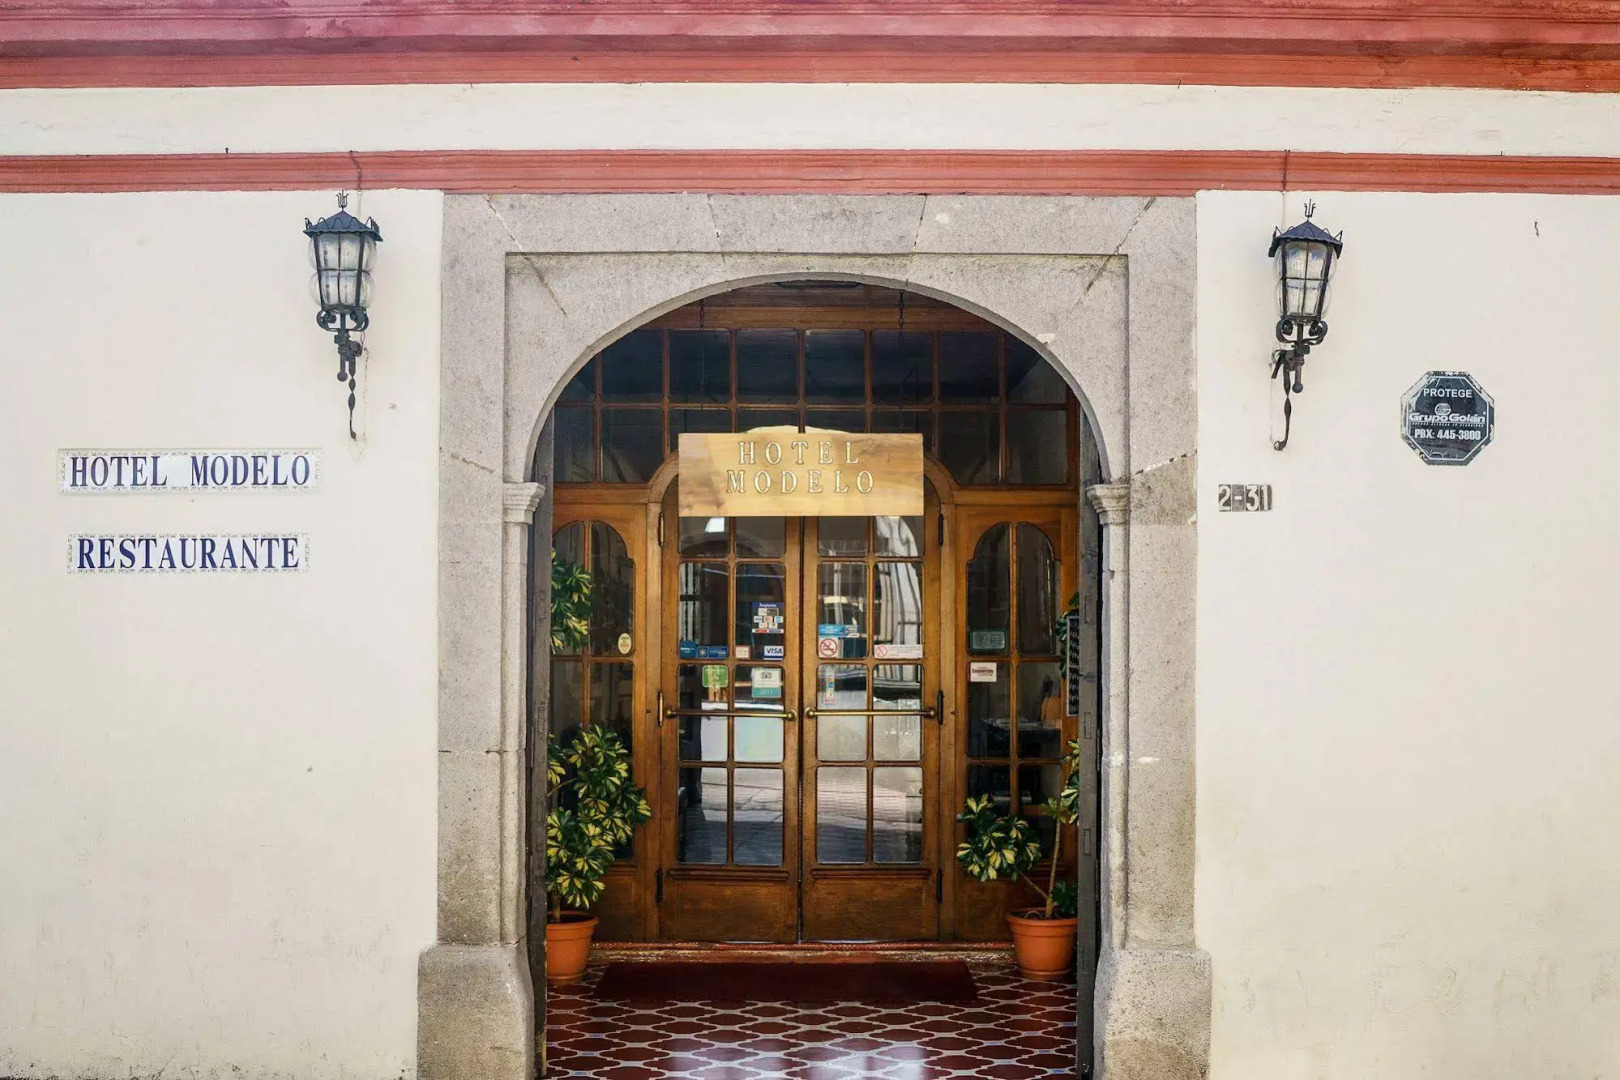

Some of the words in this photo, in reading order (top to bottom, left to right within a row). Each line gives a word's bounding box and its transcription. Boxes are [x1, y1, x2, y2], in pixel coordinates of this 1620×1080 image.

[1423, 388, 1473, 398] PROTEGE
[1414, 428, 1435, 439] PBX:
[1437, 429, 1481, 440] 445-3800
[738, 441, 859, 465] HOTEL
[70, 456, 168, 487] HOTEL
[190, 455, 310, 486] MODELO
[726, 470, 874, 494] MODELO
[1219, 485, 1268, 511] 2-31
[77, 538, 299, 569] RESTAURANTE
